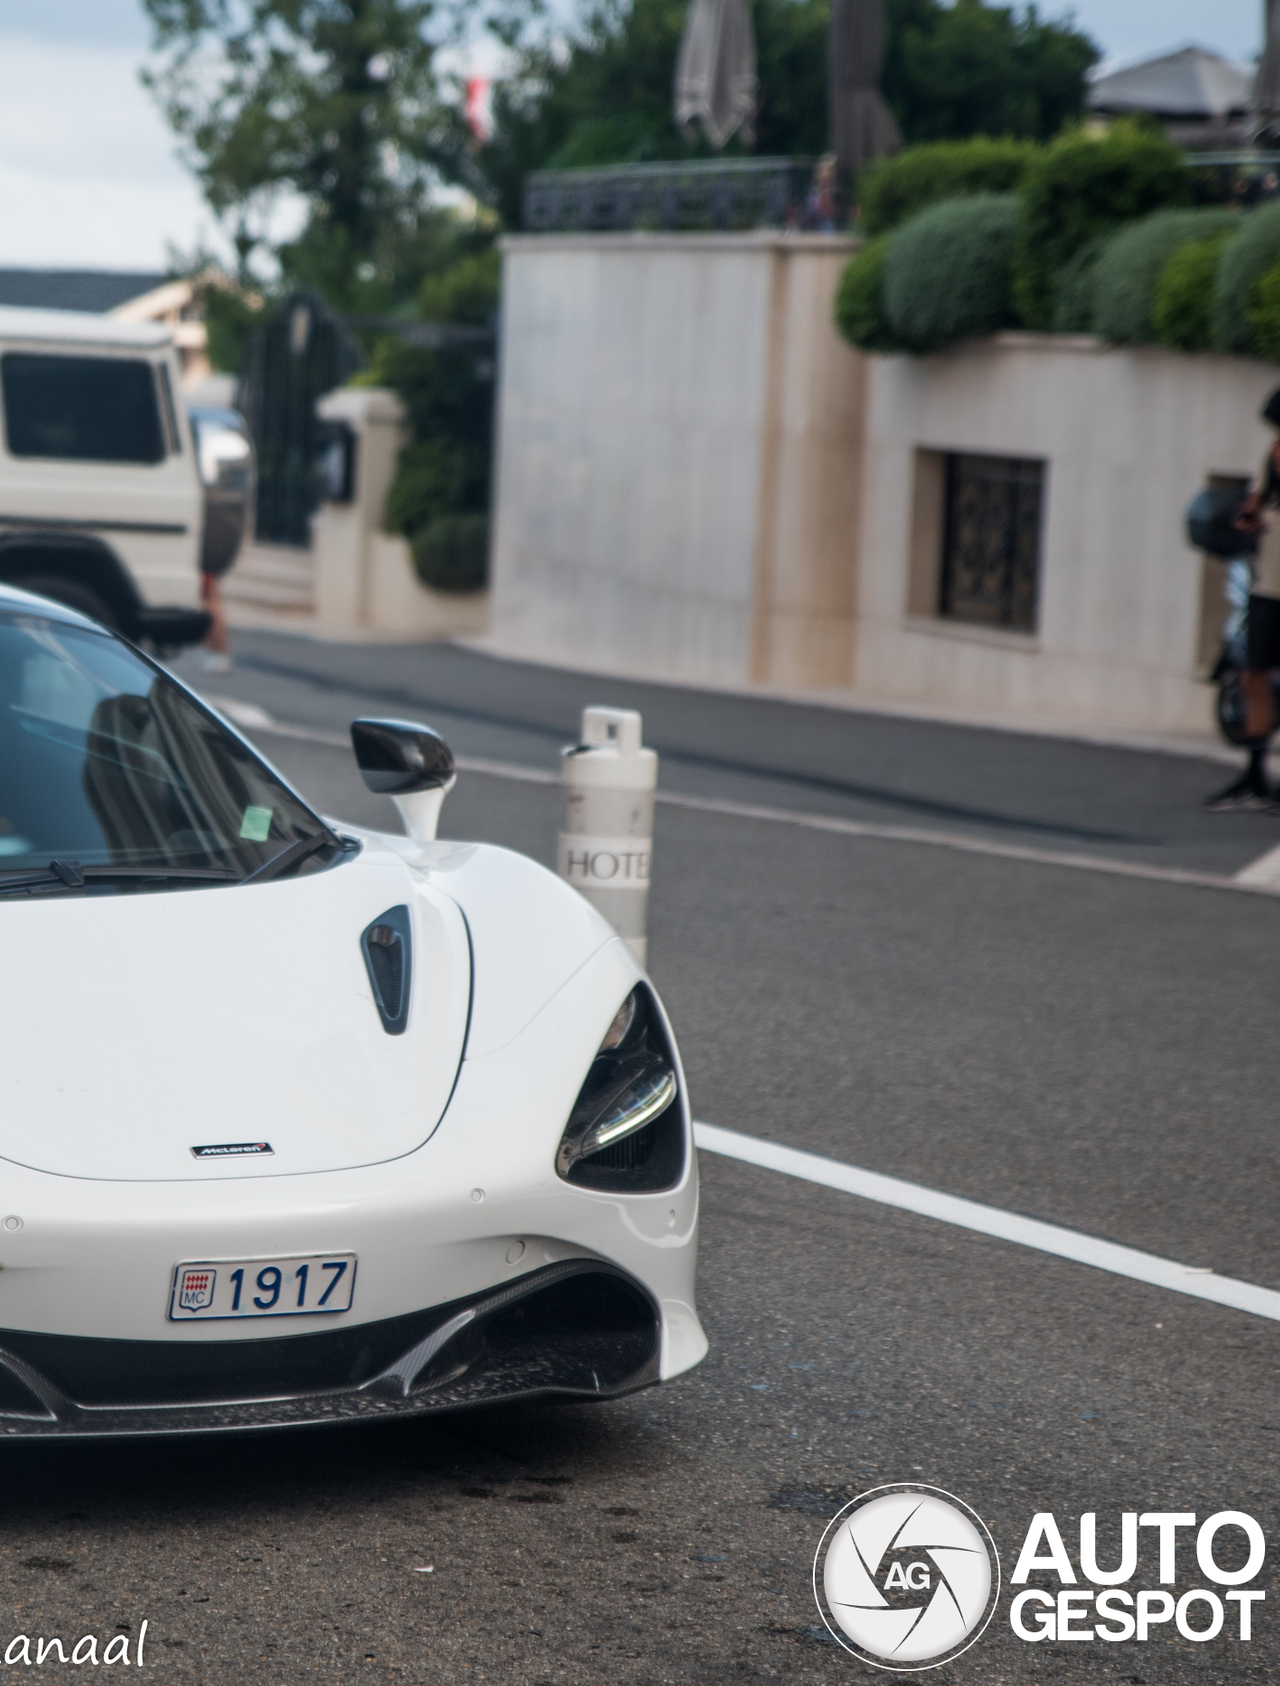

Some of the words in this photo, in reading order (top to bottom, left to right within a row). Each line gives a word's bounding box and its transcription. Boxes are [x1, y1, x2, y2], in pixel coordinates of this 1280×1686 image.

[201, 1145, 262, 1155] McLaren
[184, 1292, 205, 1304] MC
[230, 1261, 348, 1311] 1917
